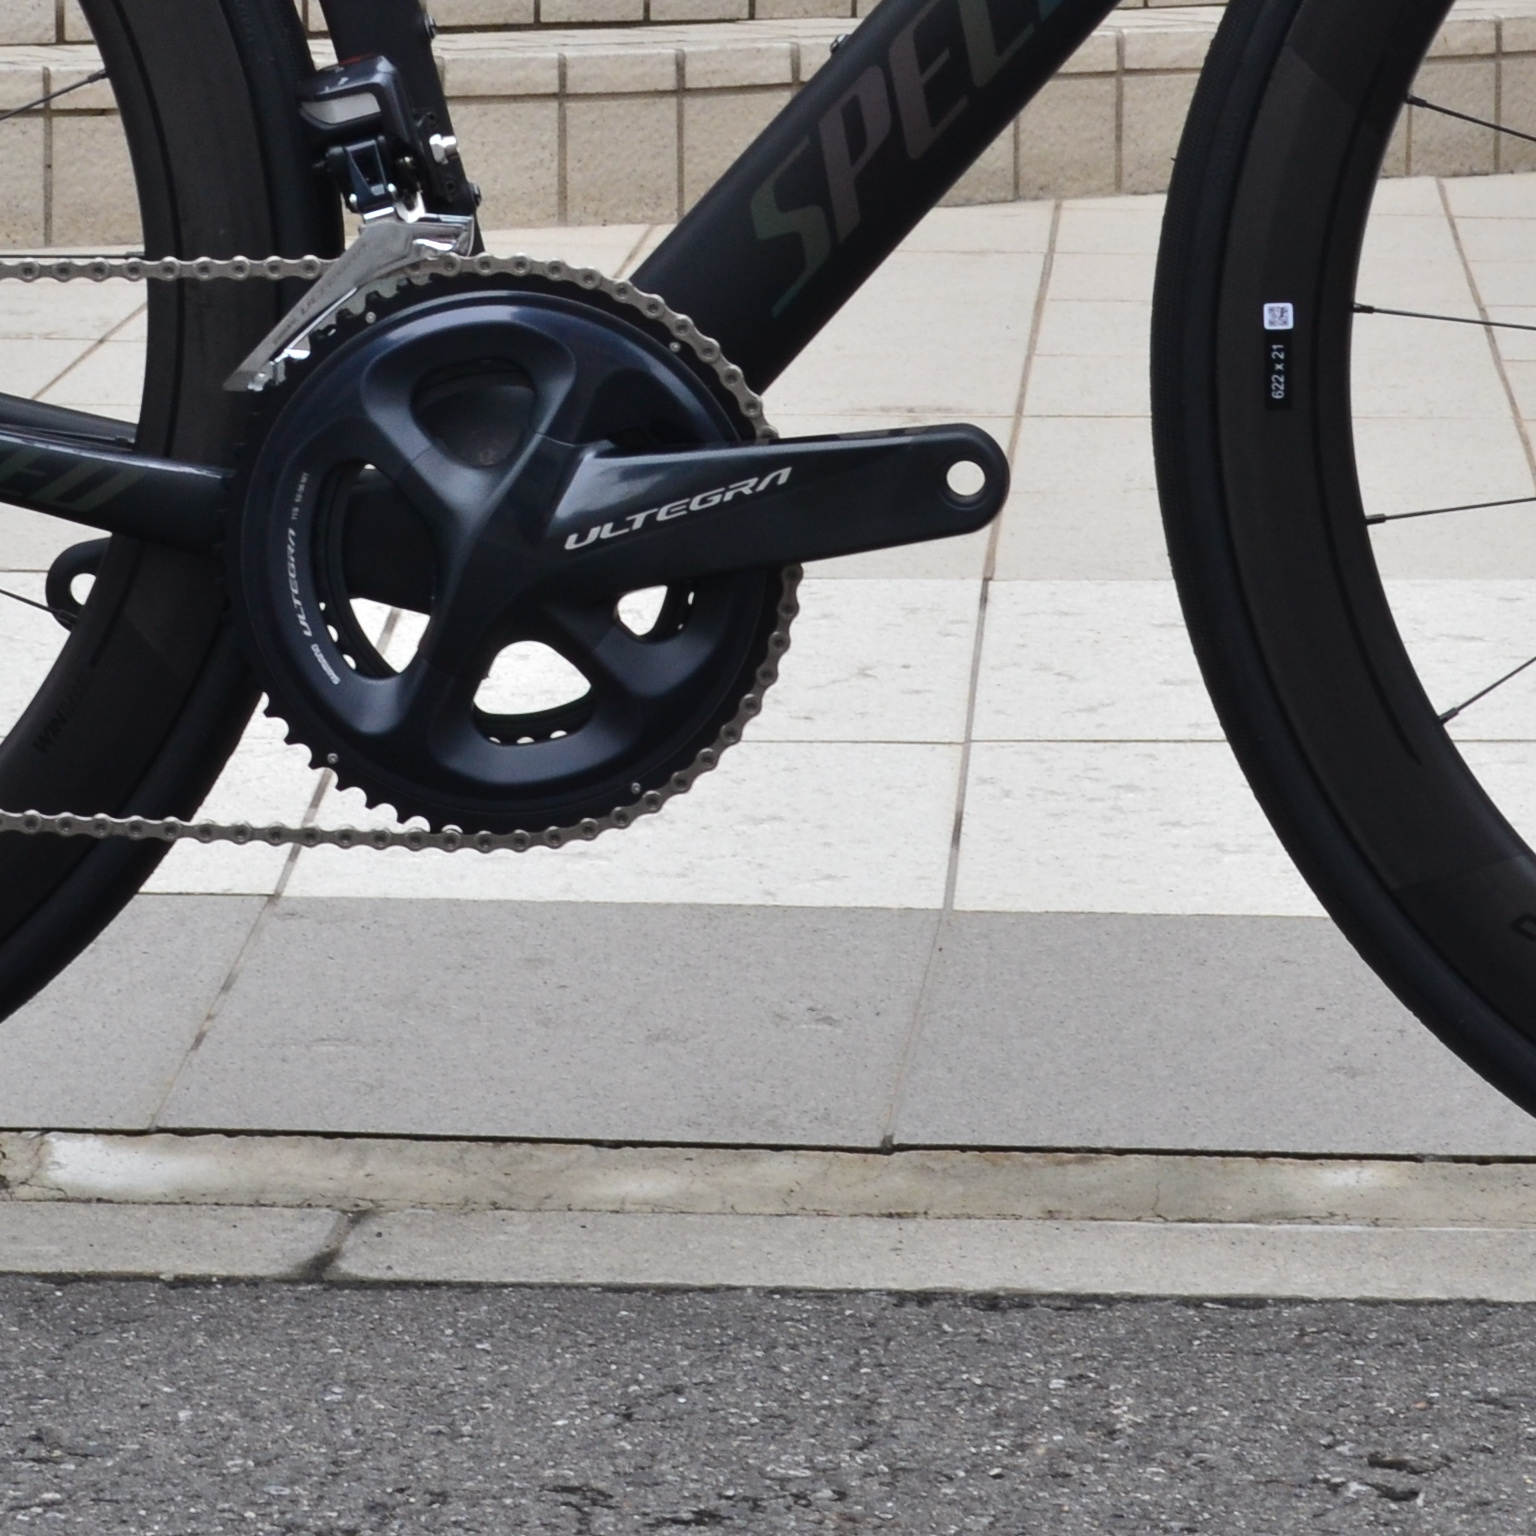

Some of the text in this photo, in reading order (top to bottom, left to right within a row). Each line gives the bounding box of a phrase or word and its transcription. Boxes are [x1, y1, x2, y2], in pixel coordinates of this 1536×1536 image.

[1271, 343, 1285, 360] 21
[1271, 374, 1285, 400] 622
[564, 466, 793, 551] ULTEGRA
[286, 526, 313, 638] ULTEGRA
